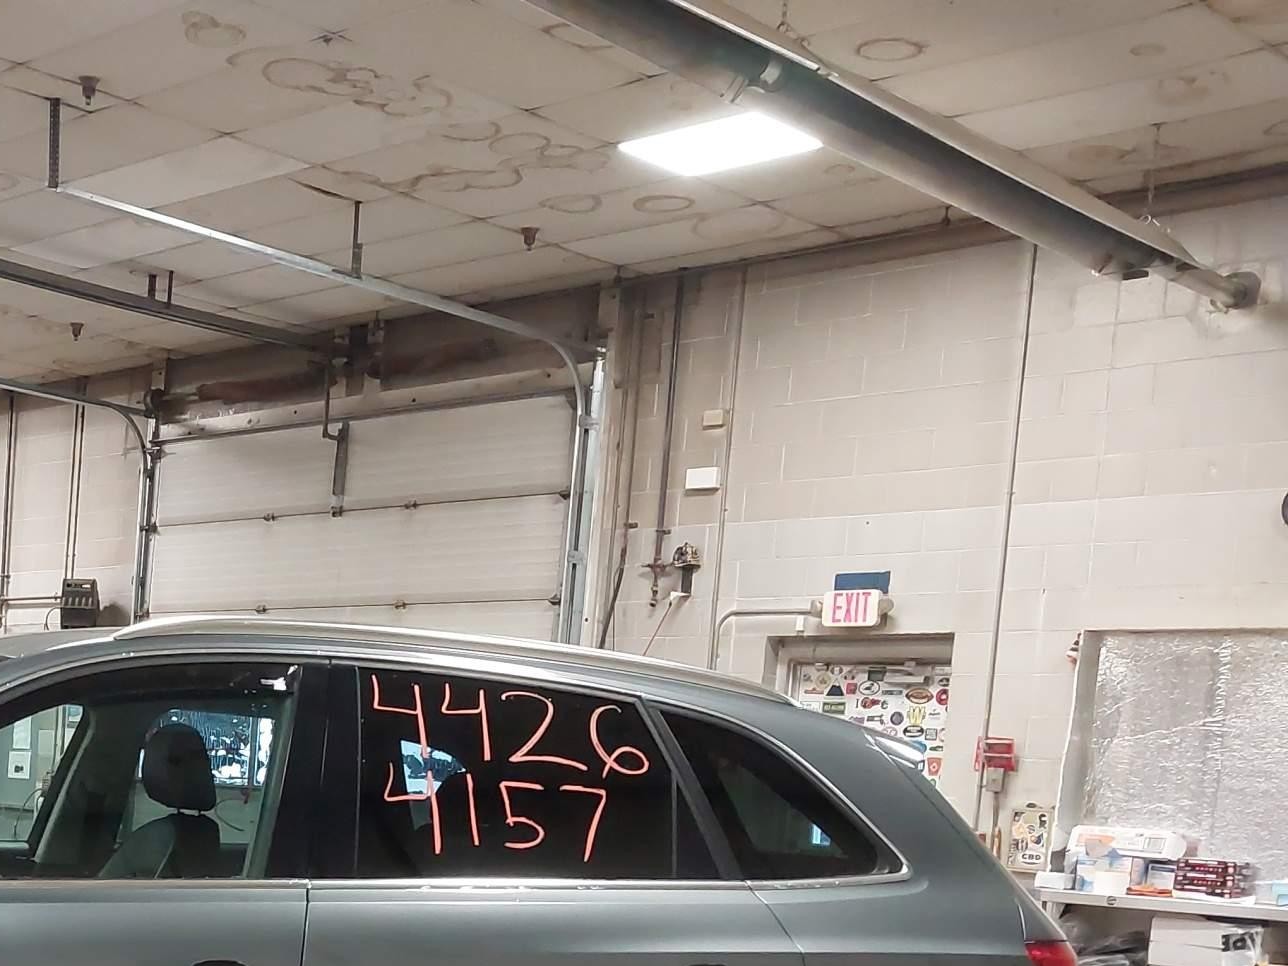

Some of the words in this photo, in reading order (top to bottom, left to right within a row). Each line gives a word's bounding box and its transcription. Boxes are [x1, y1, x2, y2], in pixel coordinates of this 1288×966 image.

[831, 592, 871, 622] EXIT
[371, 674, 650, 779] 4426
[384, 762, 607, 863] 4157
[1021, 853, 1042, 861] CBD
